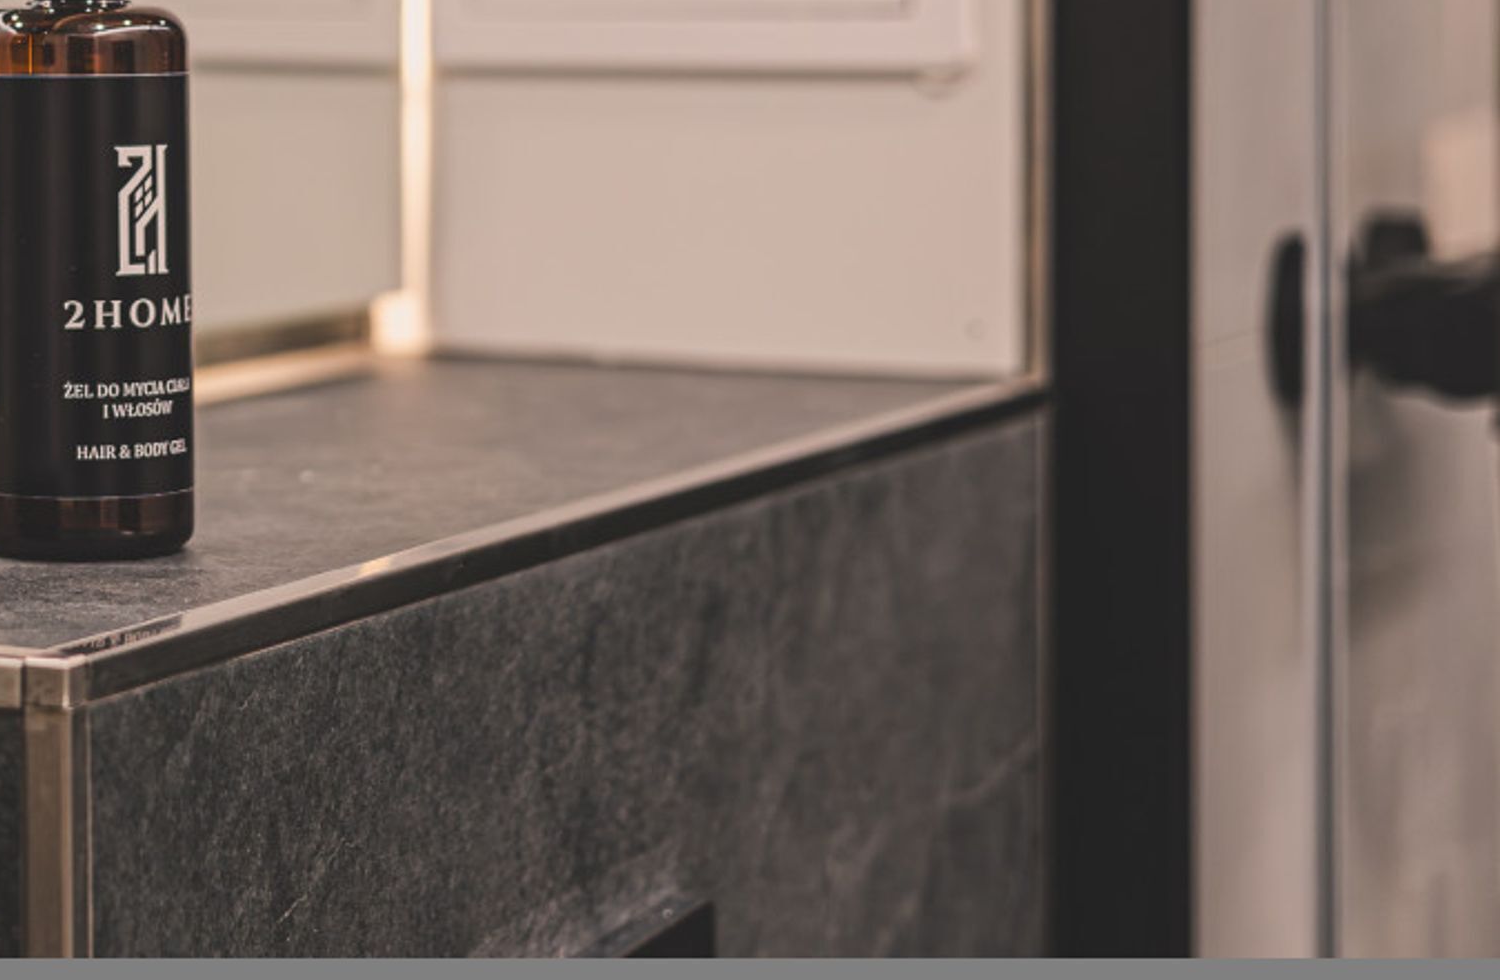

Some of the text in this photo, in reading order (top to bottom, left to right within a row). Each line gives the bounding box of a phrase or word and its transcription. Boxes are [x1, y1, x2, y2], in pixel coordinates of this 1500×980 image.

[63, 293, 192, 330] 2HOME
[63, 381, 94, 399] ŻEL
[97, 382, 120, 398] DO
[122, 380, 166, 397] MYCIA
[102, 398, 174, 419] I WŁOSÓW
[76, 438, 187, 460] HAIR & BODY GEL
